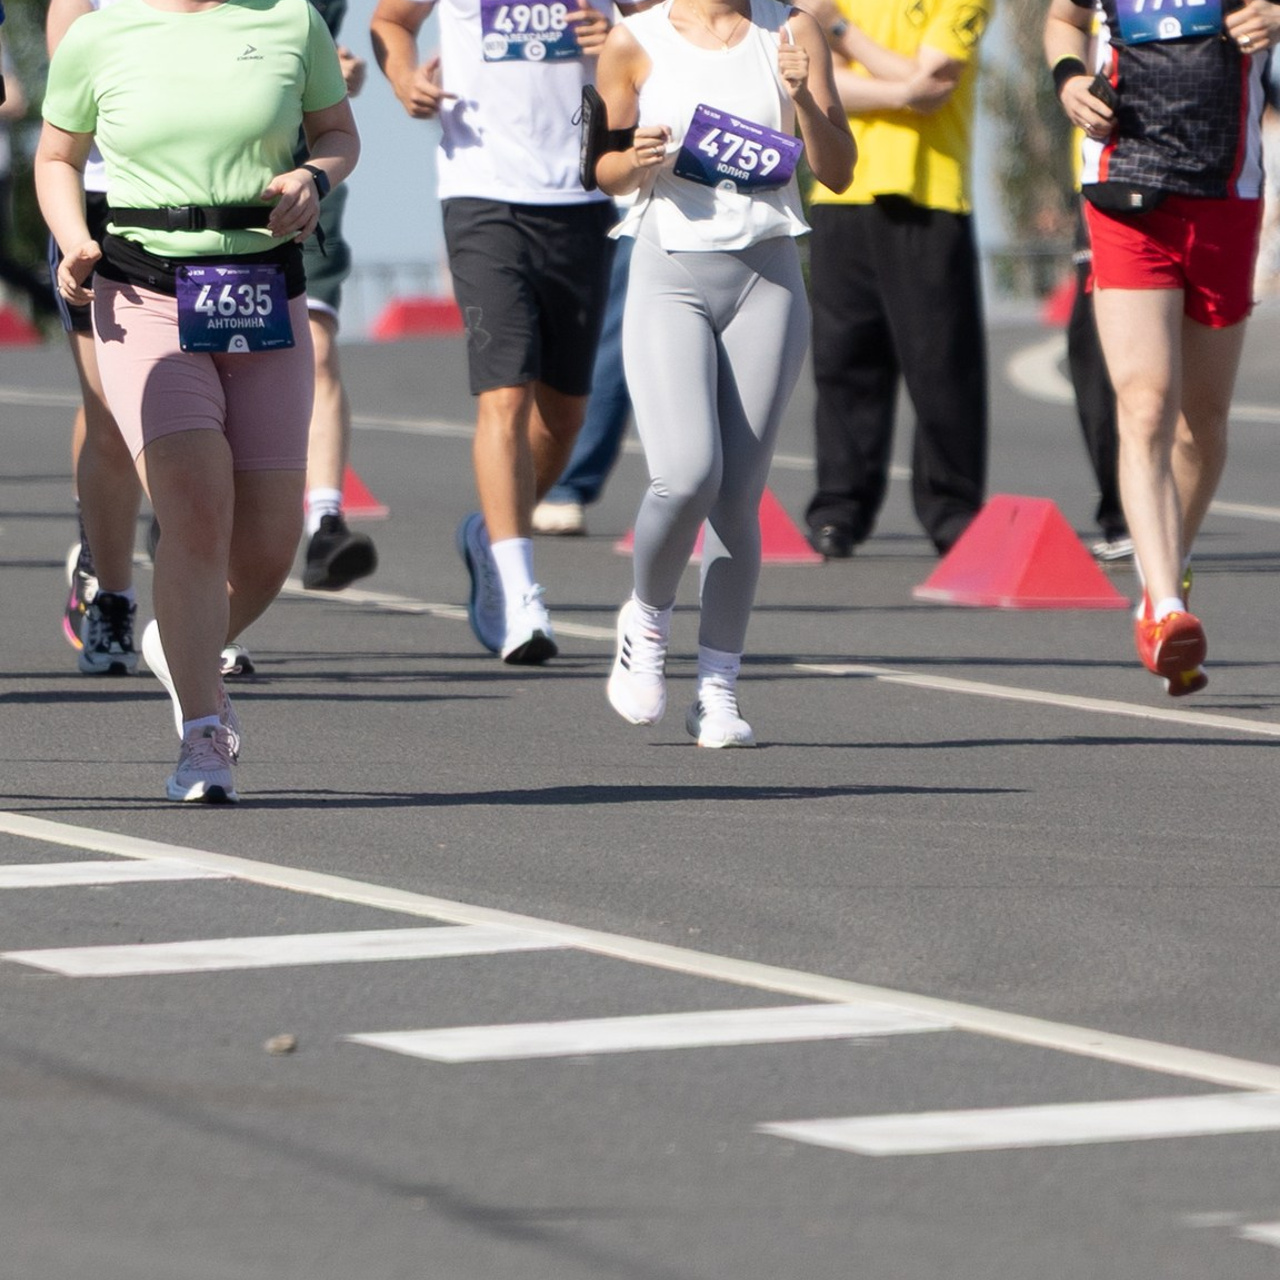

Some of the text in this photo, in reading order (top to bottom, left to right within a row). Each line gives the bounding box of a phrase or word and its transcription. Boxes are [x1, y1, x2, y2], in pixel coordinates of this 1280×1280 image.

[494, 2, 568, 32] 4908
[698, 127, 781, 177] 4759
[716, 163, 750, 180] ЮЛИЯ
[195, 284, 273, 316] 4635
[207, 317, 265, 329] АНТОНИНА
